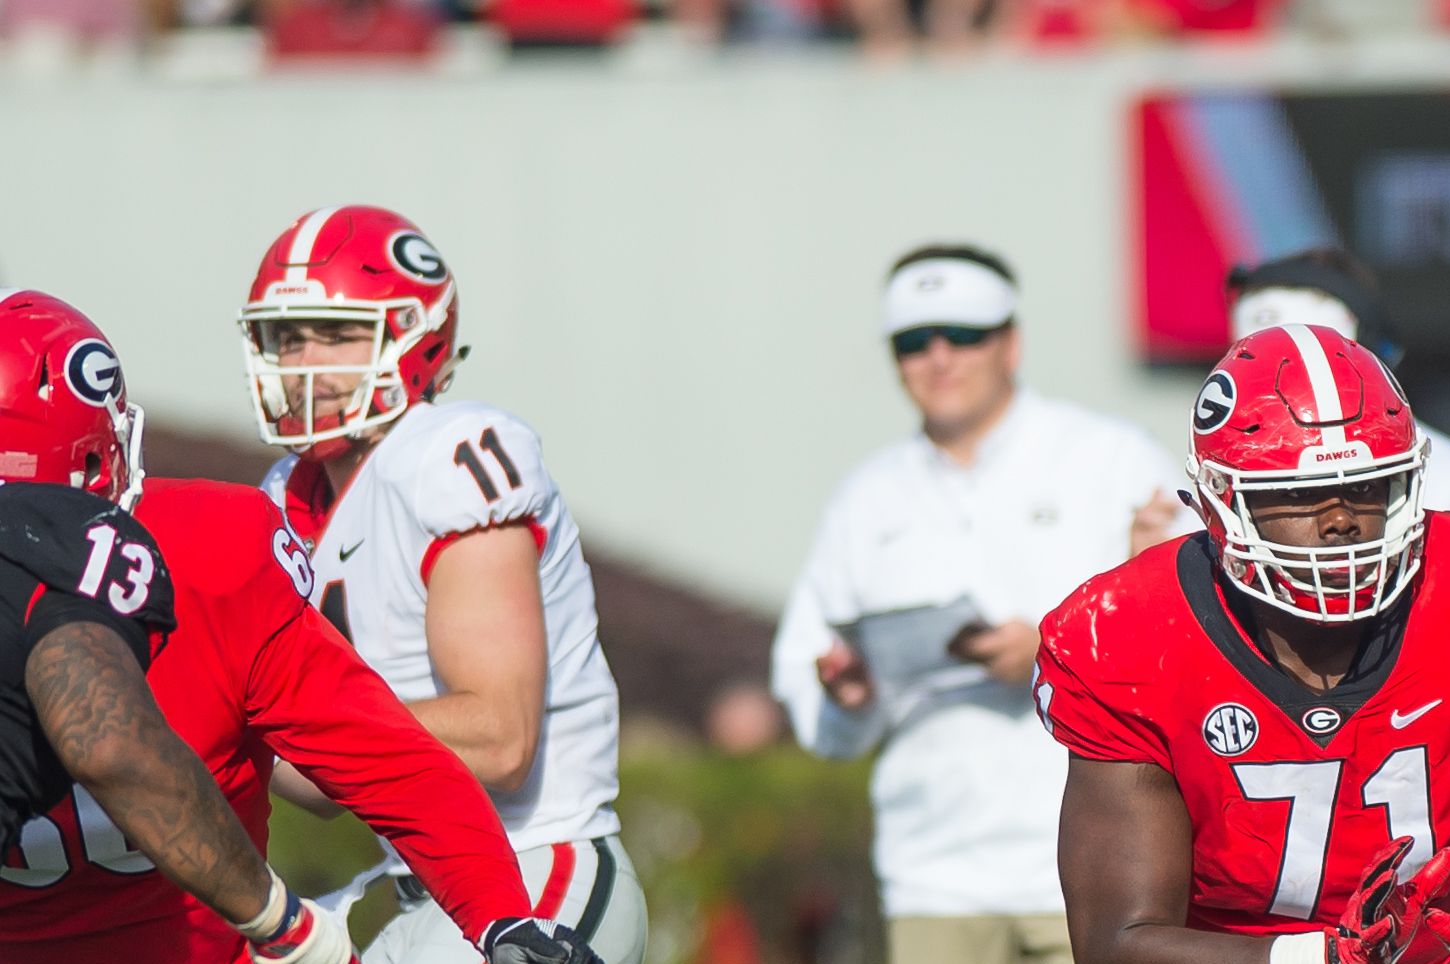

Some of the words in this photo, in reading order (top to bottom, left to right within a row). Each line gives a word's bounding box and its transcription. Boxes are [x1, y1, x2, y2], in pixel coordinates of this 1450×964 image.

[393, 233, 448, 281] G
[69, 341, 122, 404] G
[1194, 372, 1236, 432] G
[455, 427, 524, 504] 11
[1315, 448, 1358, 463] DAWGS
[80, 524, 156, 616] 13
[1205, 705, 1256, 754] SEC
[1304, 709, 1340, 732] G
[1232, 744, 1436, 921] 71
